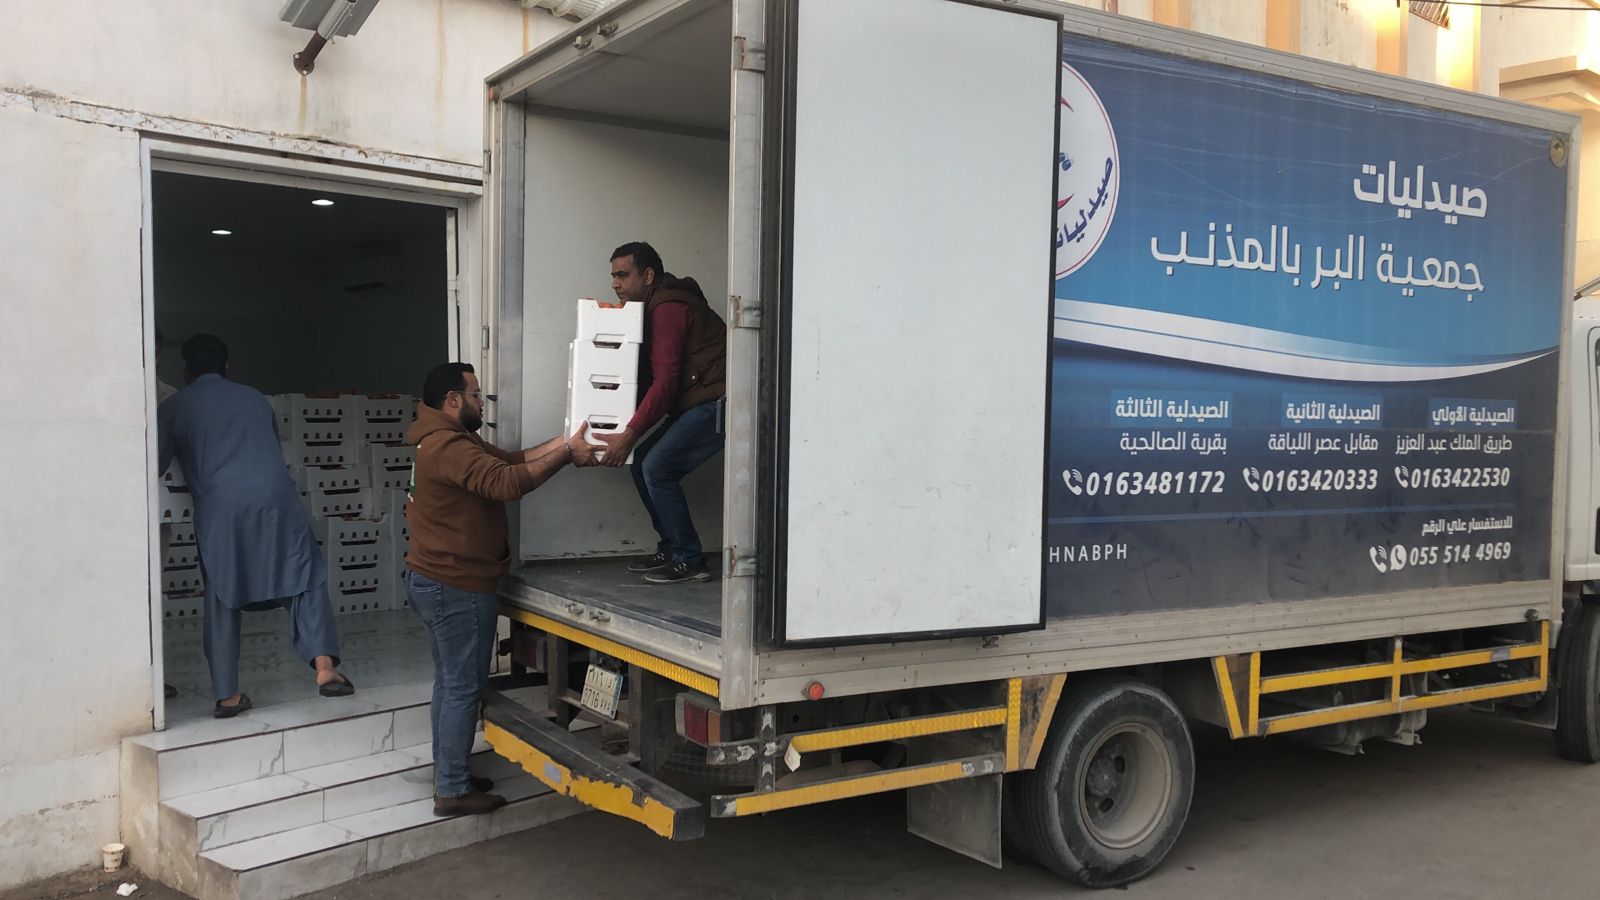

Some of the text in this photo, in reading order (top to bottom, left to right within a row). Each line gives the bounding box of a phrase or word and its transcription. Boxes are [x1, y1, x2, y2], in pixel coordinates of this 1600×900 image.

[1353, 160, 1489, 226] صيدليات
[1150, 221, 1486, 303] جمعية البر بالمذنب
[1115, 396, 1229, 422] الصيدلية الثالثة
[1286, 401, 1381, 425] الصيدلية الثانية
[1469, 407, 1515, 426] الصيدلية
[1119, 430, 1228, 455] بقرية الصالحية
[1267, 432, 1379, 455] مقابل عصر اللياقة
[1395, 433, 1513, 455] طريق الملك عبد العزيز
[1086, 470, 1226, 496] 0163481172
[1261, 468, 1379, 493] 0163420333
[1410, 466, 1511, 489] 0163422530
[1421, 515, 1514, 537] للاستفسار علي الرقم
[1049, 543, 1127, 564] HNABPH
[1409, 541, 1512, 567] 055 514 4969
